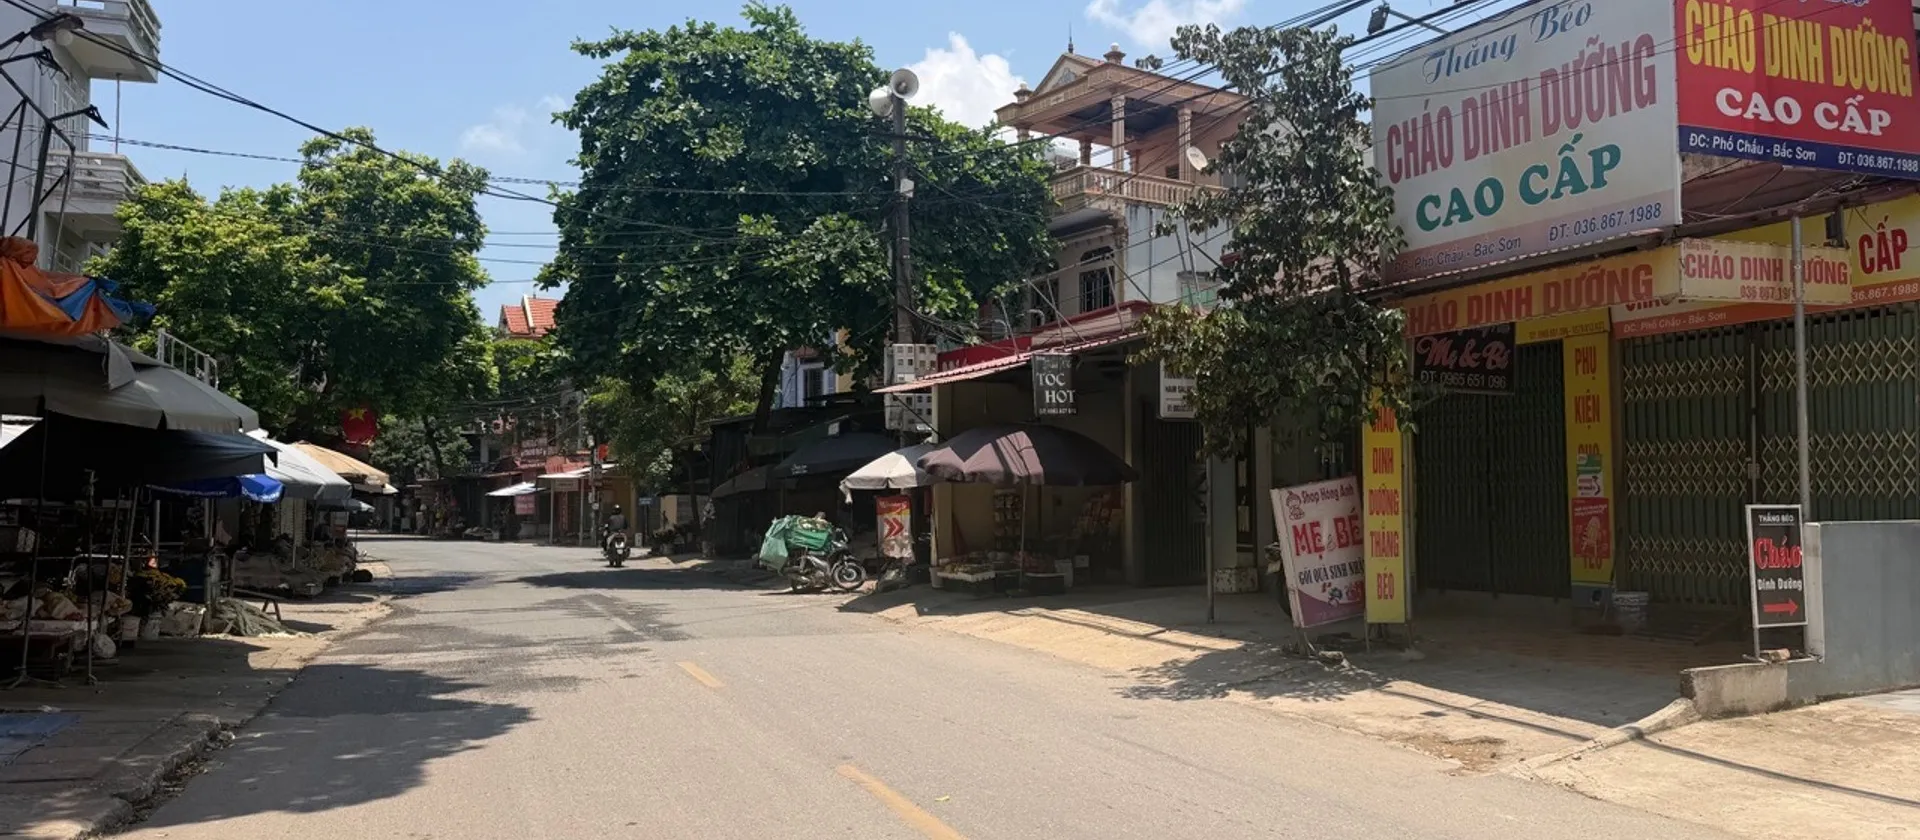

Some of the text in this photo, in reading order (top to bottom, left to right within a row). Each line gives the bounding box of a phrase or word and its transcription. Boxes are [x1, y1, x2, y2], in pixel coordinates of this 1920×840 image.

[1530, 2, 1594, 43] Béo
[1685, 0, 1913, 97] CHÁO DINH DƯỠNG
[1386, 33, 1657, 184] CHÁO DINH DƯỠNG
[1716, 87, 1892, 136] CAO CẤP
[1689, 133, 1710, 148] ĐC:
[1712, 135, 1734, 151] Phố
[1773, 141, 1793, 158] Bắc
[1795, 146, 1816, 161] Sơn
[1838, 151, 1919, 172] ĐT: 036.867.1988
[1416, 133, 1622, 232] CAO CẤP
[1549, 202, 1662, 242] ĐT: 036.867.1988
[1498, 236, 1521, 251] Sơn
[1858, 214, 1908, 274] CẤP
[1685, 249, 1735, 280] CHÁO
[1740, 256, 1783, 282] DINH
[1406, 264, 1654, 335] HÁO DINH DƯỠNG
[1852, 283, 1918, 301] 36.867.1988
[1458, 337, 1482, 368] &
[1574, 345, 1597, 380] PHỤ
[1045, 390, 1076, 404] HOT
[1467, 373, 1485, 388] 651
[1488, 376, 1507, 388] 096
[1574, 389, 1601, 430] KIỆN
[1372, 447, 1395, 474] DINH
[1301, 490, 1320, 506] Shop
[1292, 521, 1325, 561] MẸ
[1754, 535, 1803, 570] Cháo
[1376, 566, 1396, 600] BÉO
